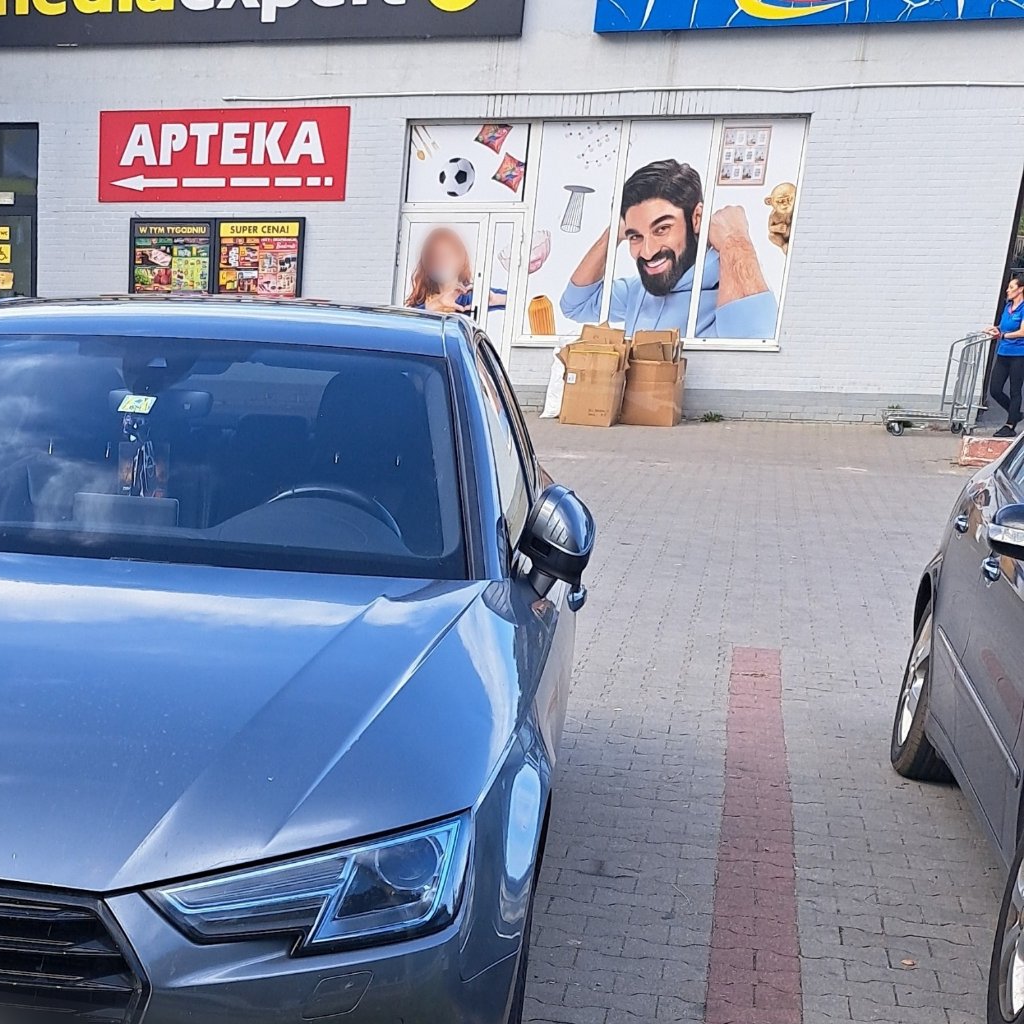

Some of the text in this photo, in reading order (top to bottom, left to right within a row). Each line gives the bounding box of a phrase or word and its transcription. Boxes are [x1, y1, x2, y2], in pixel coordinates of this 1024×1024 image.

[119, 121, 325, 166] APTEKA
[166, 226, 207, 234] TYGODNIU
[230, 225, 290, 234] SUPER CENA!
